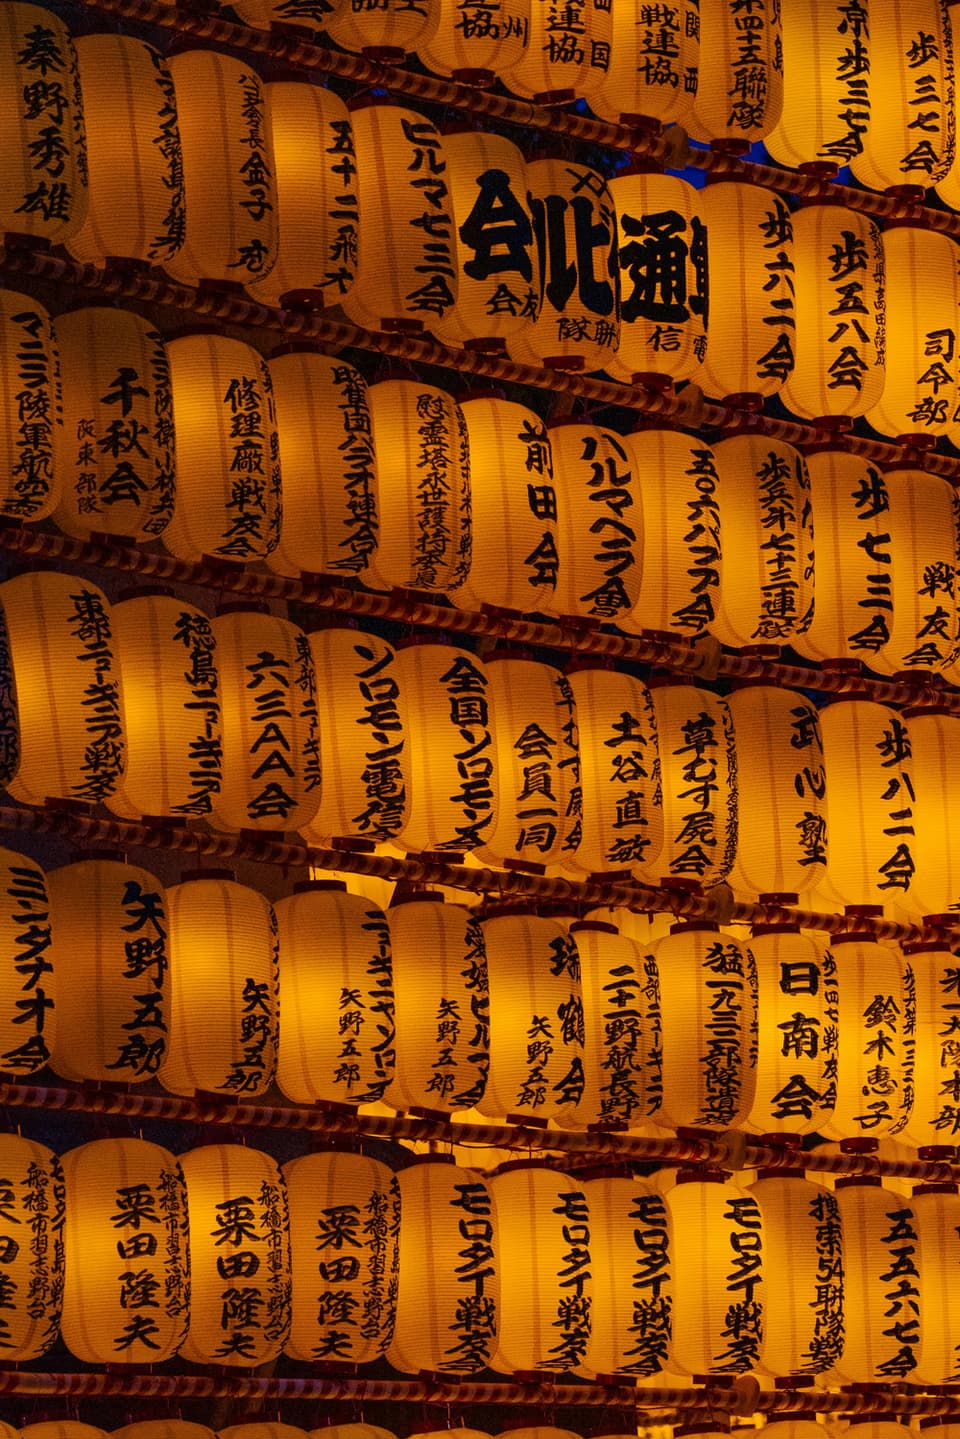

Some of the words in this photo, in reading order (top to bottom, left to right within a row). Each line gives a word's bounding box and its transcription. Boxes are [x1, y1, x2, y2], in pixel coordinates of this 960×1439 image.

[15, 24, 72, 223] 秦野秀雄
[902, 32, 941, 173] 歩三七会
[756, 200, 799, 385] 歩六二会
[826, 231, 871, 391] 歩五八会
[99, 366, 149, 506] 千秋会
[905, 327, 957, 425] 司令部
[517, 418, 560, 587] 前田会
[848, 468, 893, 651] 歩七三会
[902, 560, 953, 667] 戦友会
[513, 722, 558, 854] 会員一同
[875, 717, 917, 894] 歩八二会
[105, 879, 170, 1076] 矢野五郎
[213, 977, 277, 1093] 矢野五郎
[332, 985, 366, 1088] 矢野五郎
[424, 996, 461, 1096] 矢野五郎
[515, 1014, 555, 1110] 矢野五郎
[853, 994, 902, 1128] 鈴木恵子
[109, 1182, 163, 1351] 栗田隆夫
[208, 1194, 264, 1359] 栗田隆夫
[311, 1202, 364, 1361] 栗田隆夫
[873, 1209, 921, 1378] 五五六七会
